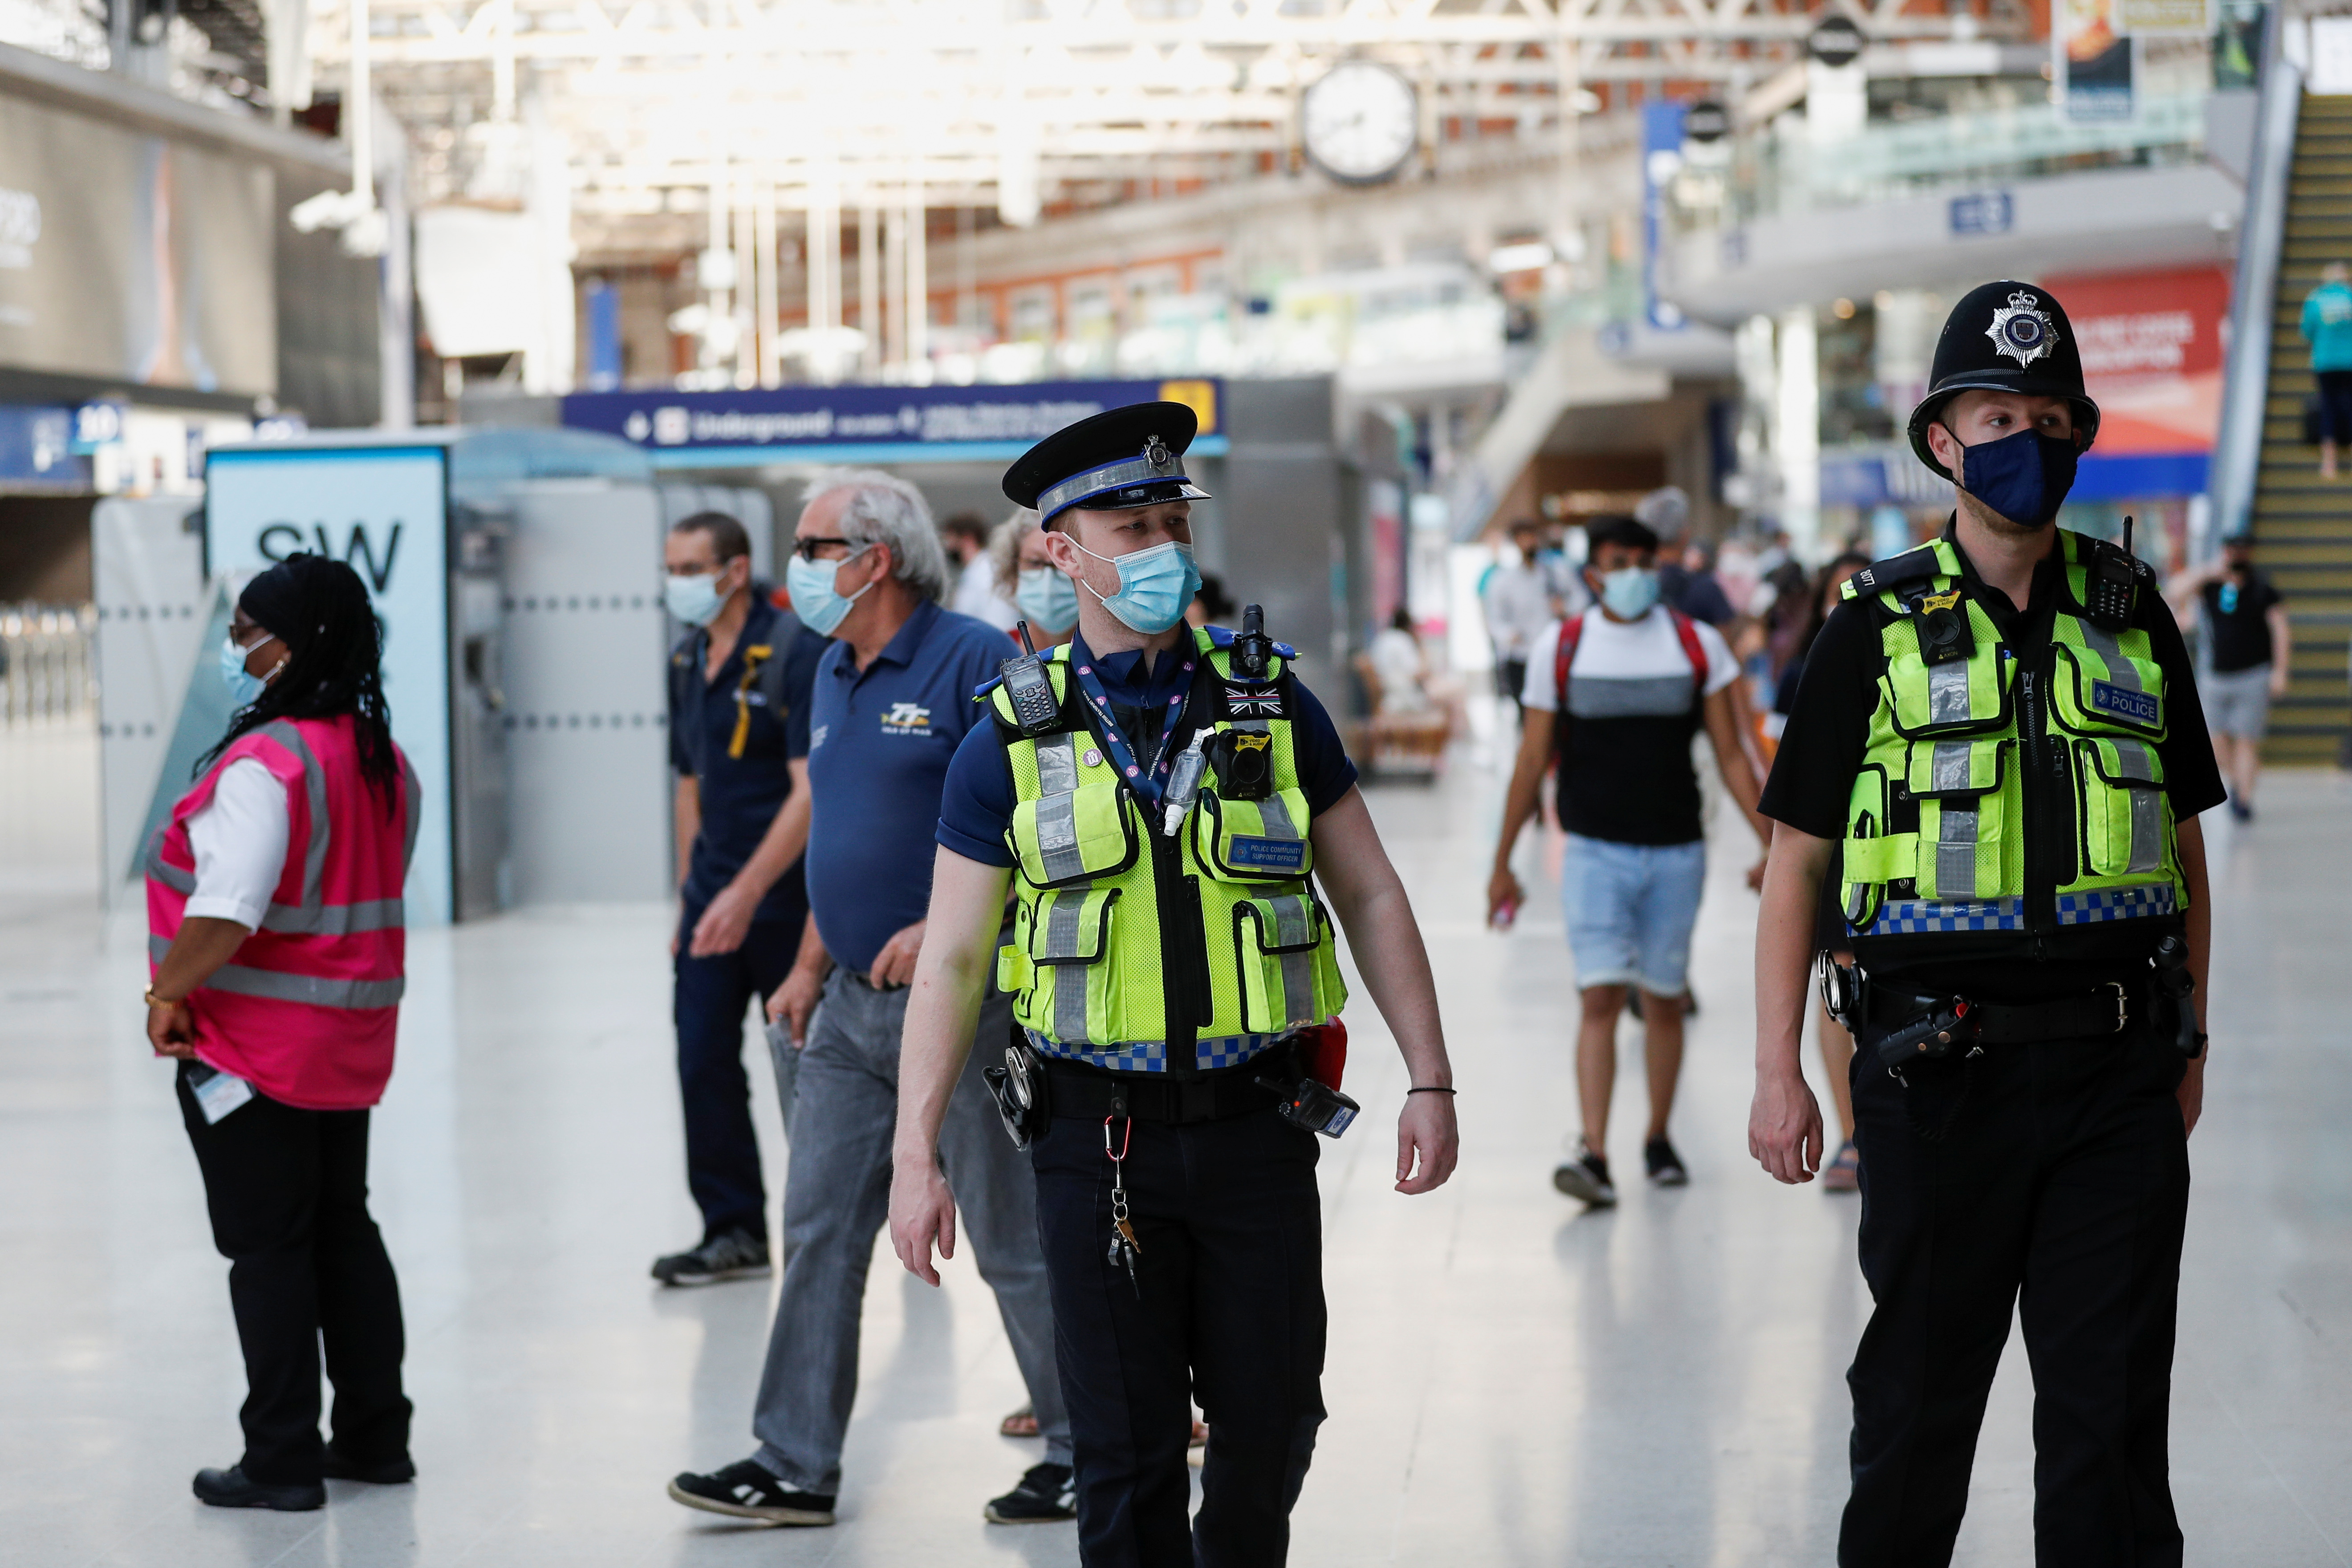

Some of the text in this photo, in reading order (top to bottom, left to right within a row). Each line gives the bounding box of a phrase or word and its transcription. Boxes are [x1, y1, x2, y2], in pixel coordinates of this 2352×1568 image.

[1860, 569, 1875, 586] 8077
[890, 703, 930, 728] TT
[2112, 696, 2155, 719] POLICE
[1102, 714, 1114, 727] BRITISH
[1270, 846, 1301, 854] COMMUNITY
